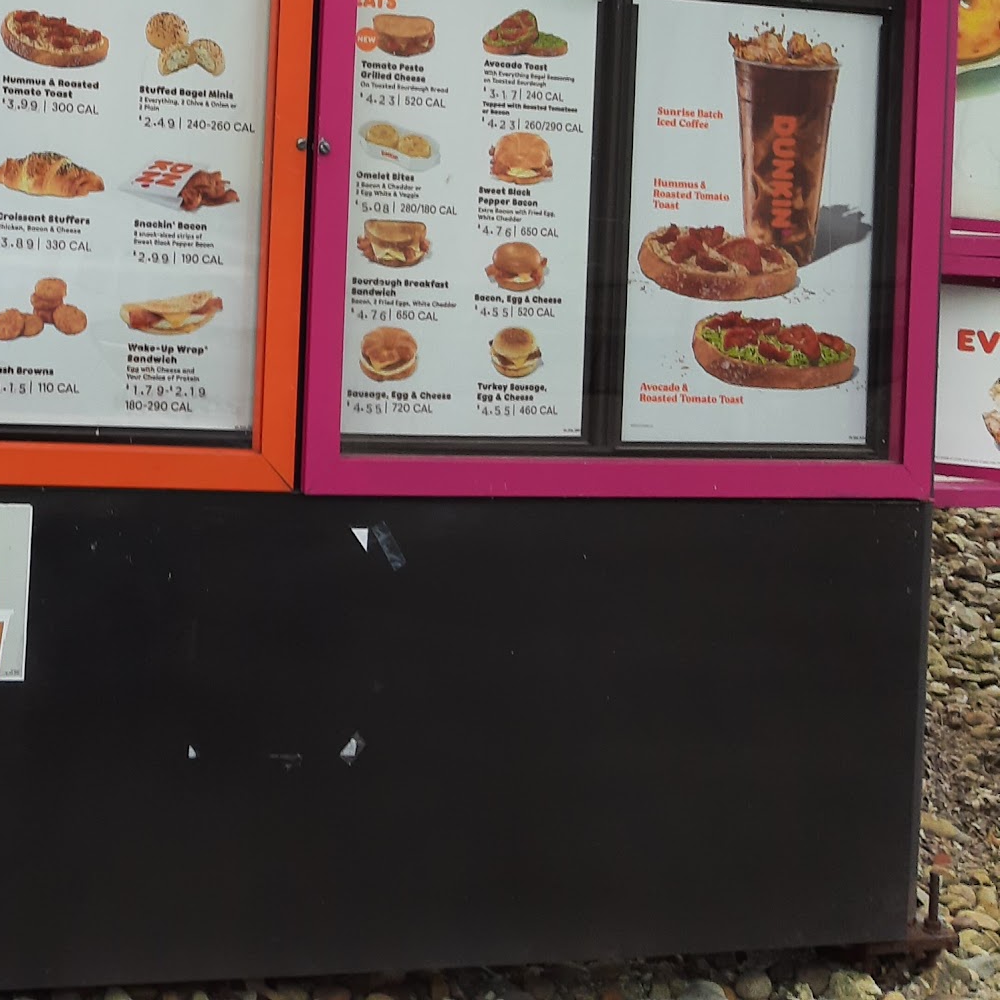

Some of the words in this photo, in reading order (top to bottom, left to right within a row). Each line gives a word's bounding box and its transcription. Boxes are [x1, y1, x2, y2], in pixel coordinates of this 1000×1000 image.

[484, 60, 523, 70] Avocado
[524, 62, 548, 72] Toast
[2, 75, 47, 86] Hummus
[57, 79, 100, 90] Roasted
[2, 86, 42, 97] Tomato
[45, 88, 73, 99] Toast
[139, 84, 177, 96] Stuffed
[179, 87, 207, 99] Bagel
[208, 89, 234, 100] Minis
[657, 106, 694, 119] Sunrise
[698, 108, 723, 120] Batch
[233, 121, 255, 133] CAL
[656, 117, 677, 128] Iced
[680, 118, 709, 130] Coffee
[653, 177, 697, 190] Hummus
[653, 188, 692, 201] Roasted
[694, 190, 730, 203] Tomato
[653, 199, 680, 211] Toast
[48, 214, 91, 225] Stuffers
[957, 328, 1000, 354] EV
[16, 366, 54, 376] Browns
[477, 383, 508, 393] Turkey
[639, 382, 679, 393] Avocado
[638, 392, 677, 404] Roasted
[680, 393, 717, 404] Tomato
[720, 393, 744, 405] Toast
